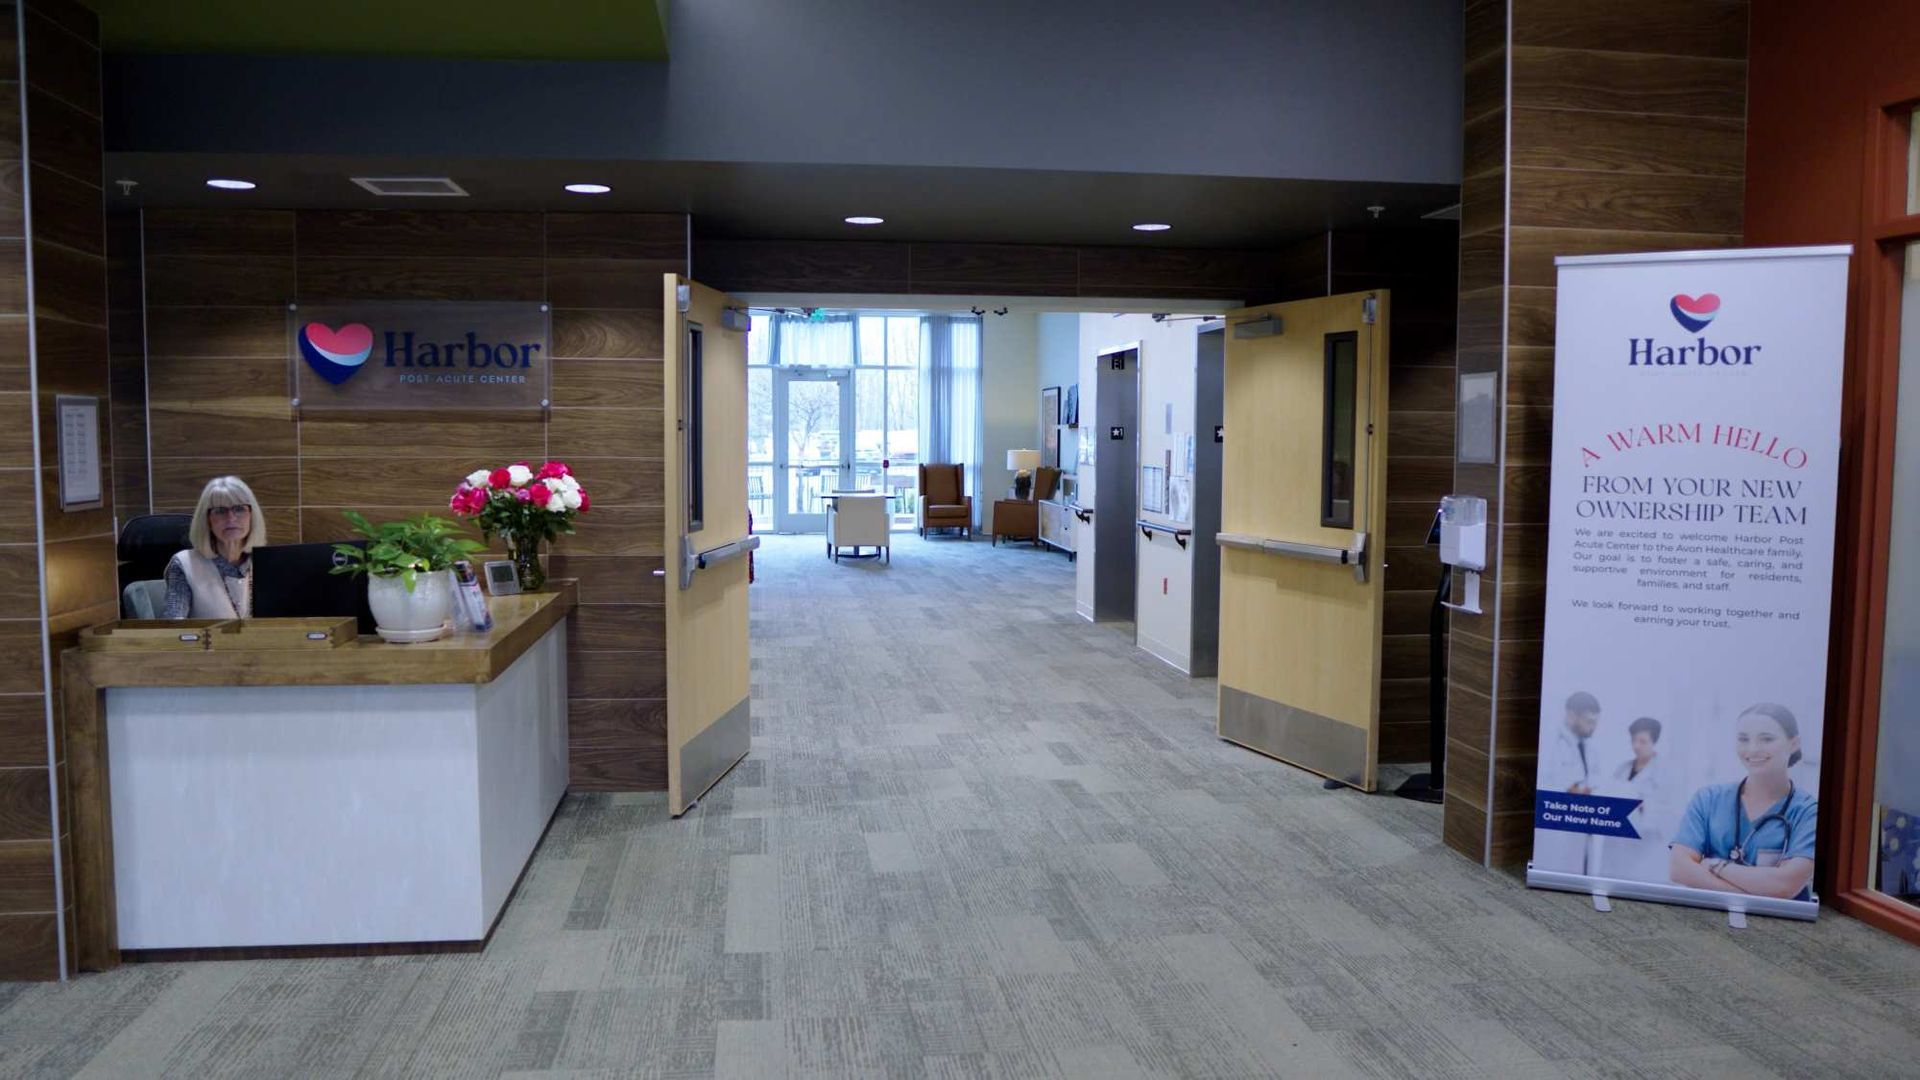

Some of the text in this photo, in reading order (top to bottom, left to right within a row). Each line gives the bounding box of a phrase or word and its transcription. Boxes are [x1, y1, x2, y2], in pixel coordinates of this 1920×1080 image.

[384, 331, 542, 369] Harbor
[1628, 337, 1762, 366] Harbor
[399, 374, 526, 384] POST ACUTE CENTER
[1581, 422, 1809, 470] A WARM HELLO
[1582, 475, 1803, 500] FROM YOUR NEW
[1576, 499, 1808, 526] OWNERSHIP TEAM
[1574, 528, 1591, 537] We
[1619, 530, 1656, 539] excited
[1662, 532, 1674, 540] to
[1679, 533, 1729, 542] welcome
[1735, 535, 1773, 544] Harbor
[1779, 536, 1804, 545] Post
[1574, 540, 1604, 549] Acute
[1606, 541, 1640, 551] Center
[1642, 543, 1654, 551] to
[1656, 544, 1674, 552] the
[1705, 545, 1765, 556] Healthcare
[1573, 551, 1593, 560] Our
[1599, 553, 1621, 563] goal
[1641, 555, 1652, 563] to
[1658, 556, 1688, 565] foster
[1781, 561, 1803, 570] and
[1573, 565, 1628, 574] supportive
[1639, 568, 1707, 577] environment
[1720, 570, 1736, 579] for
[1682, 582, 1703, 590] and
[1592, 600, 1614, 609] look
[1618, 601, 1659, 612] forward
[1662, 605, 1674, 613] to
[1677, 606, 1722, 617] working
[1726, 608, 1774, 618] together
[1778, 611, 1801, 620] and
[1634, 615, 1674, 626] earning
[1676, 618, 1700, 628] your
[1543, 800, 1611, 815] Take Note Of
[1542, 812, 1622, 828] Our New Name
